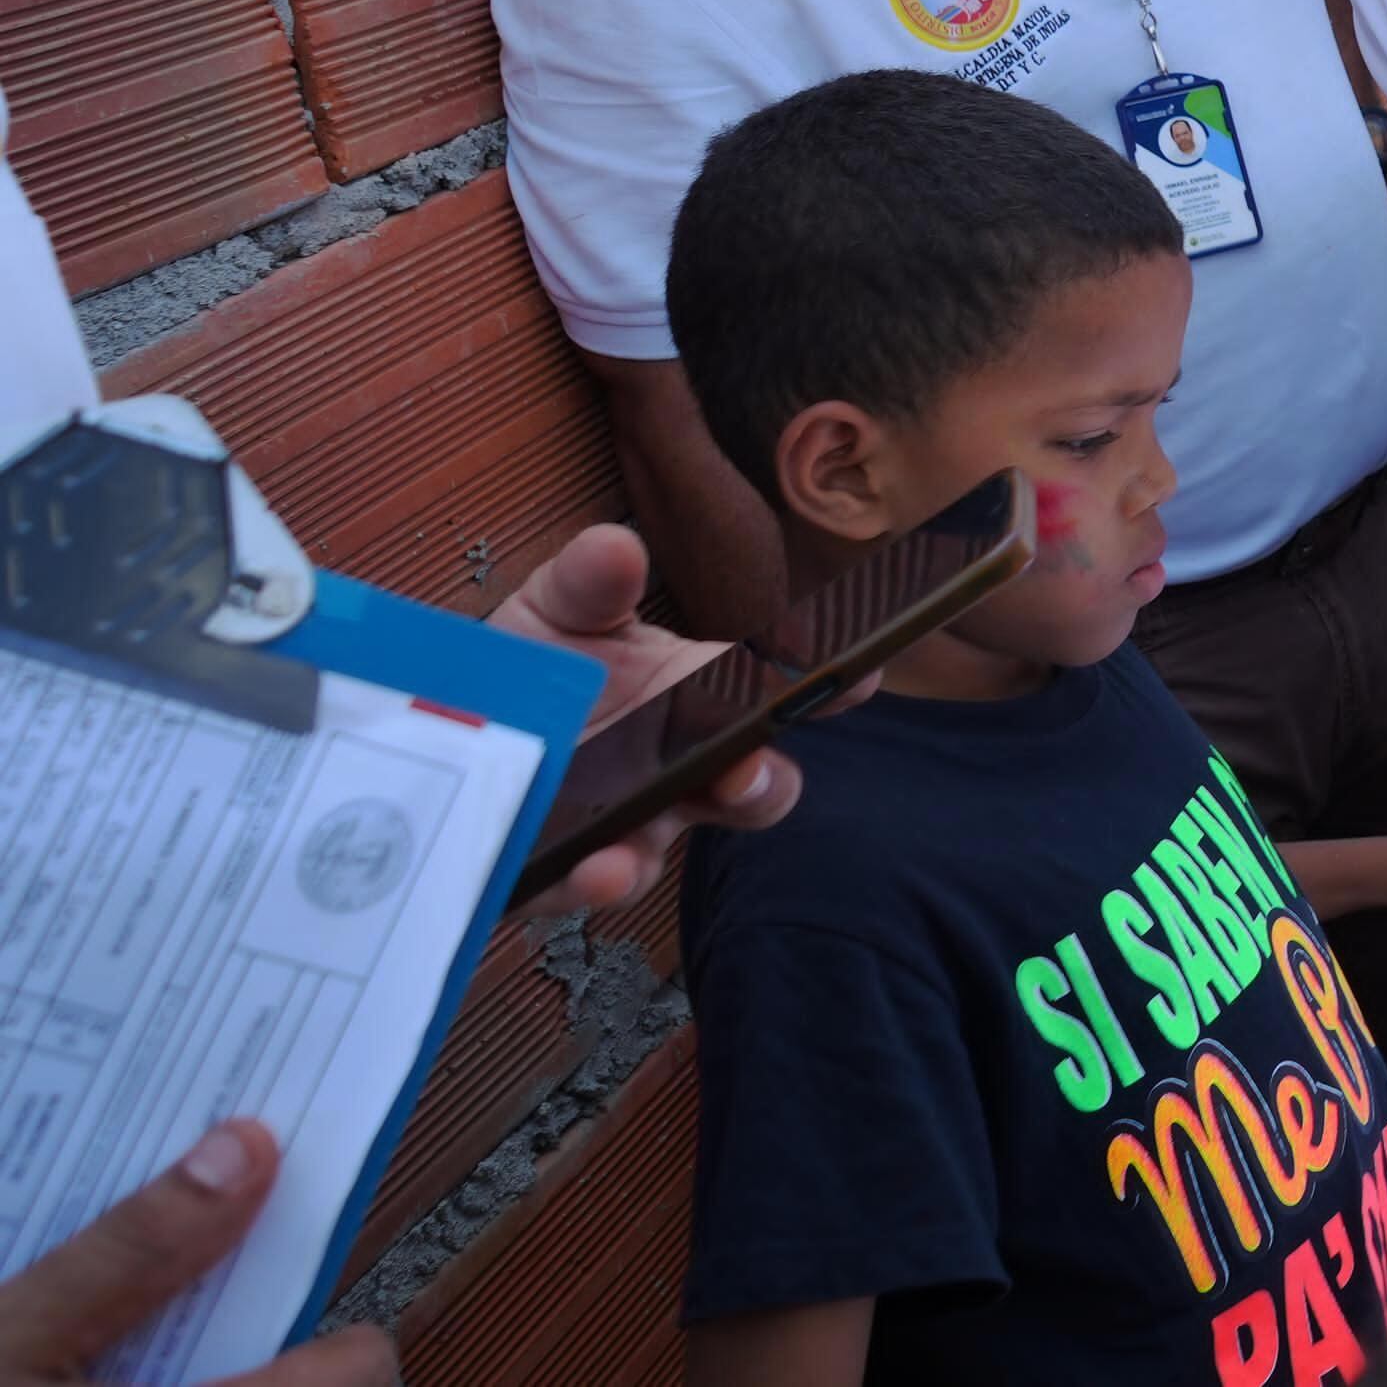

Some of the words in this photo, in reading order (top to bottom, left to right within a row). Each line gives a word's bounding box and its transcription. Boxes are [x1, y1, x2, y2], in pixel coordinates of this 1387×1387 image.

[954, 37, 1012, 80] LCALDIA
[1012, 5, 1053, 39] MAYOR
[975, 48, 1024, 86] RTAGENA
[1023, 35, 1040, 52] DE
[1038, 9, 1071, 41] INDIAS
[1016, 931, 1145, 1113] SI
[1101, 785, 1286, 1050] SABEN
